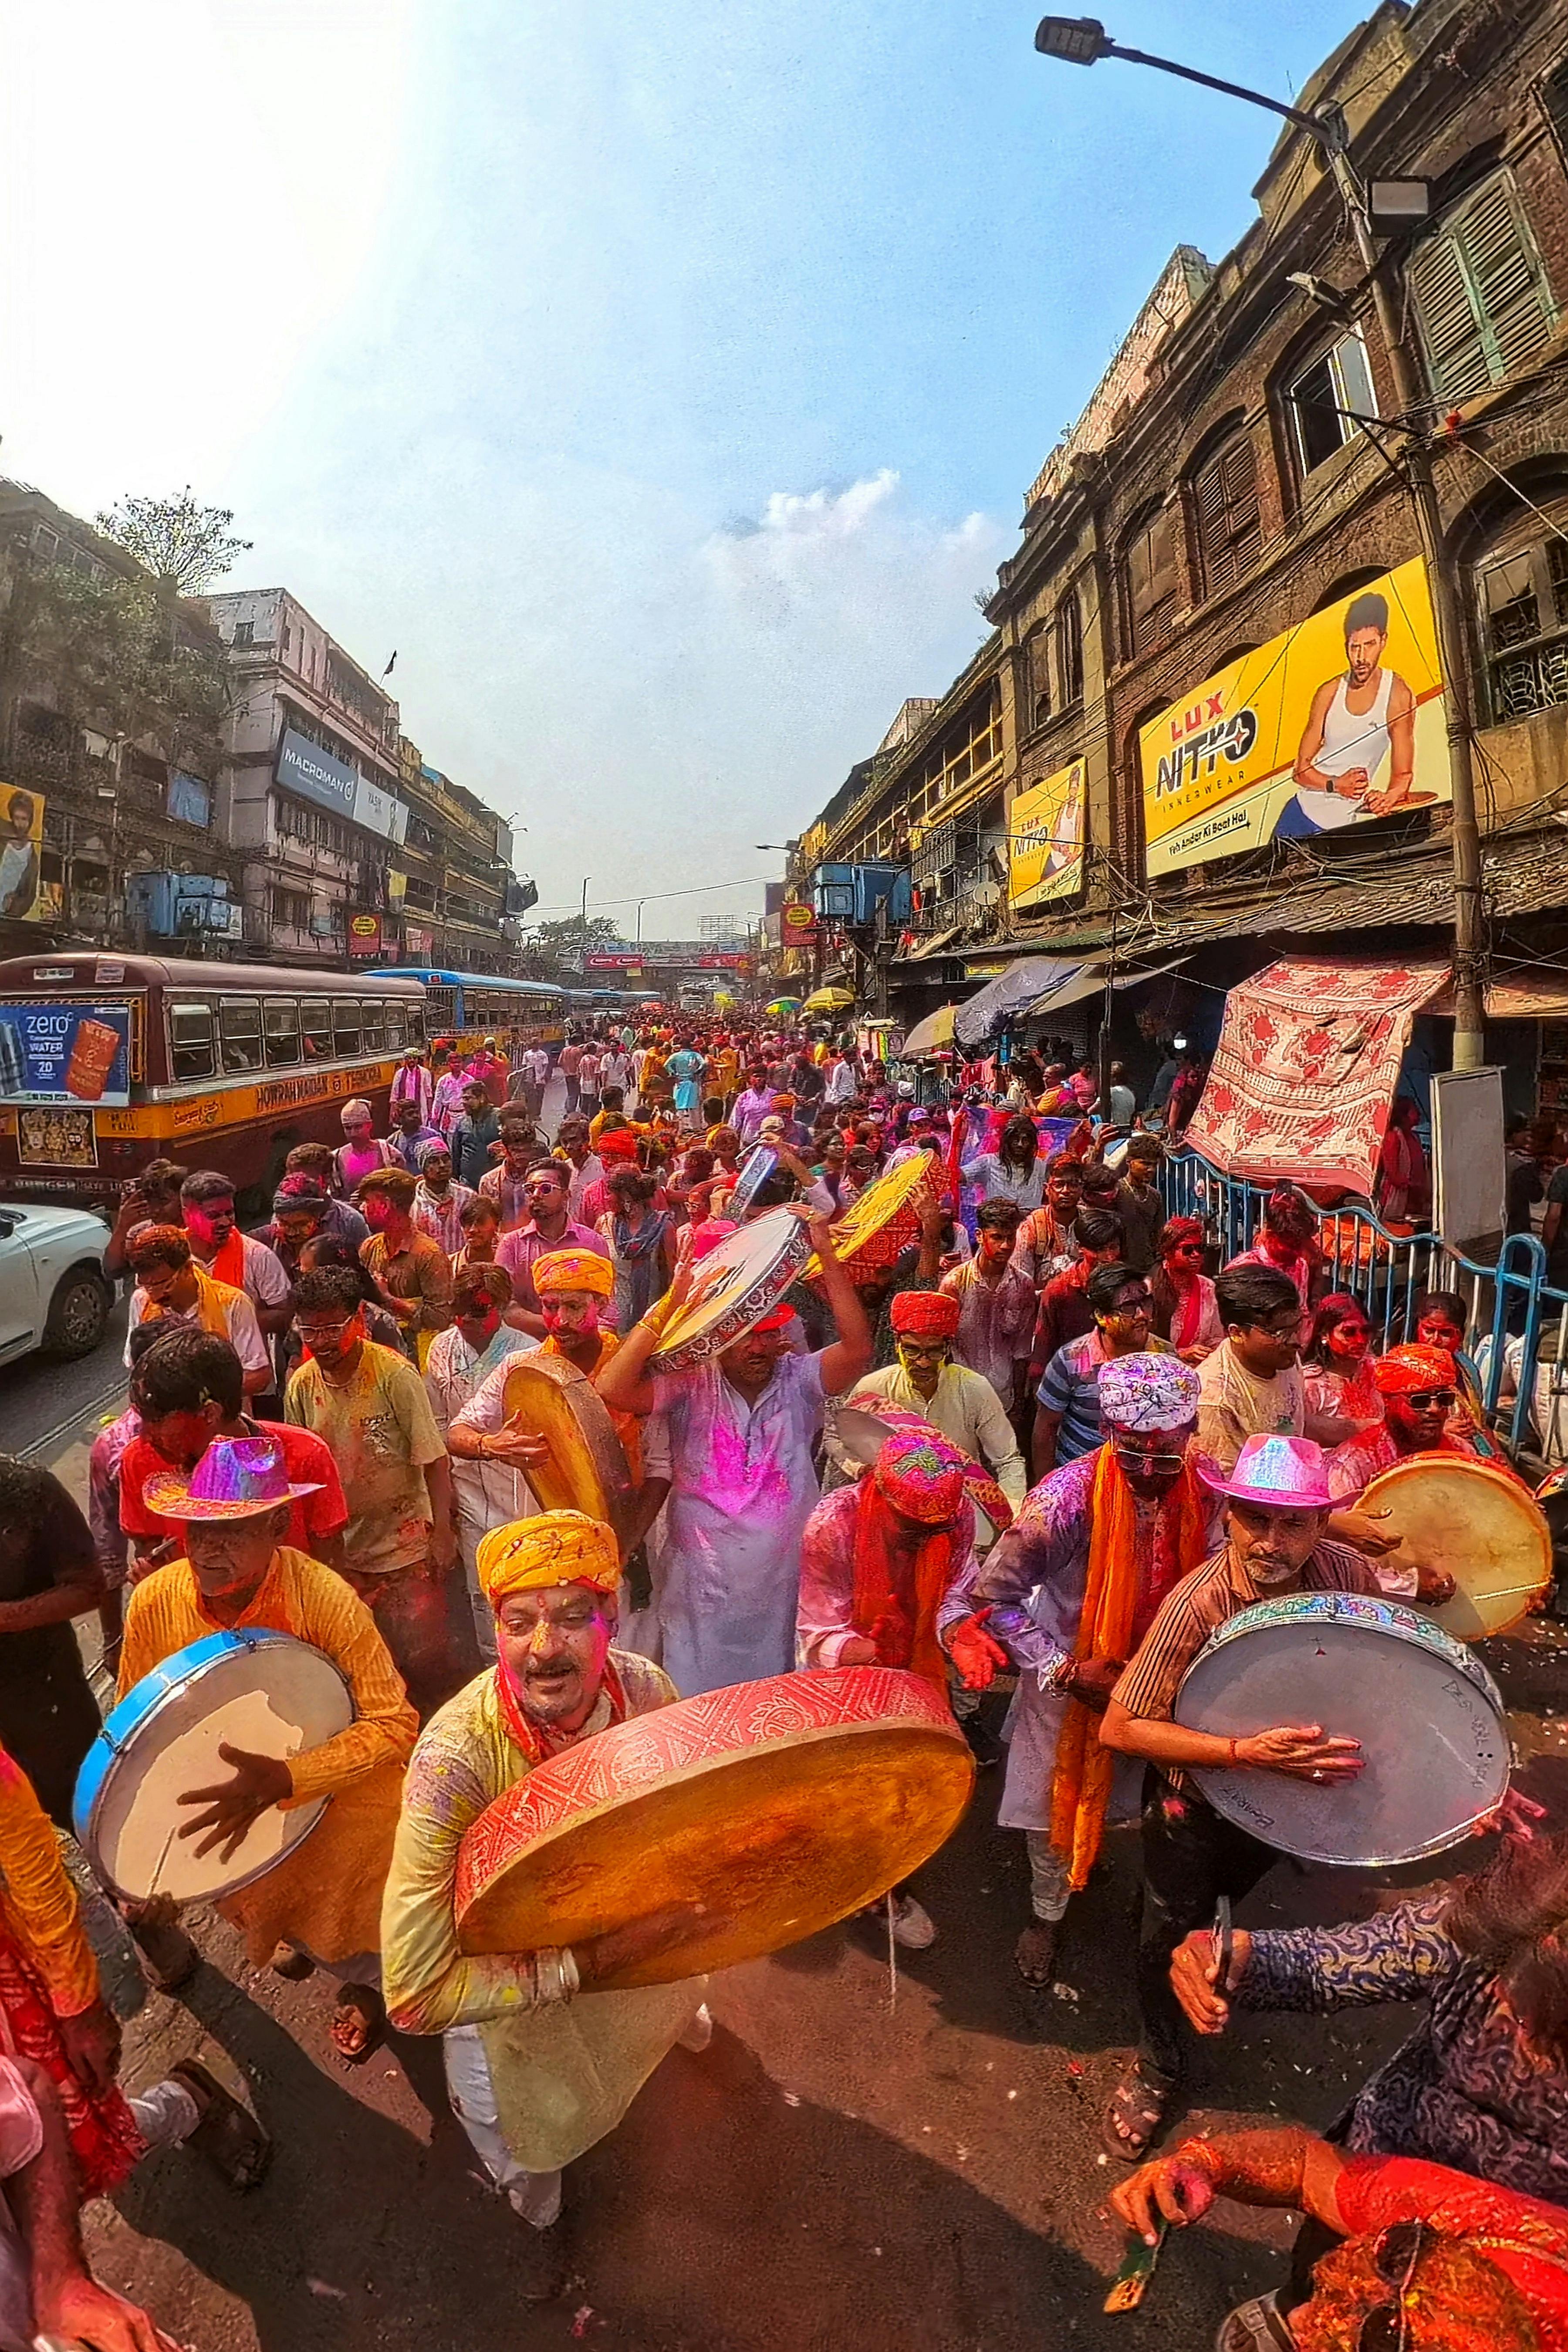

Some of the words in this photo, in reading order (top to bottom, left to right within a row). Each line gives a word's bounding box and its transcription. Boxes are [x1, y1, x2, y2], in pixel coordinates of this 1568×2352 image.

[1170, 690, 1223, 741] LUX
[284, 748, 345, 792] MACROMAN
[1156, 710, 1256, 798] NITRO
[1162, 770, 1245, 813] INNERWEAR
[1014, 826, 1048, 858] NITRO
[1022, 815, 1040, 833] LUX
[1203, 824, 1211, 838] Ki
[1232, 809, 1247, 825] Hai
[29, 1042, 63, 1053] WATER
